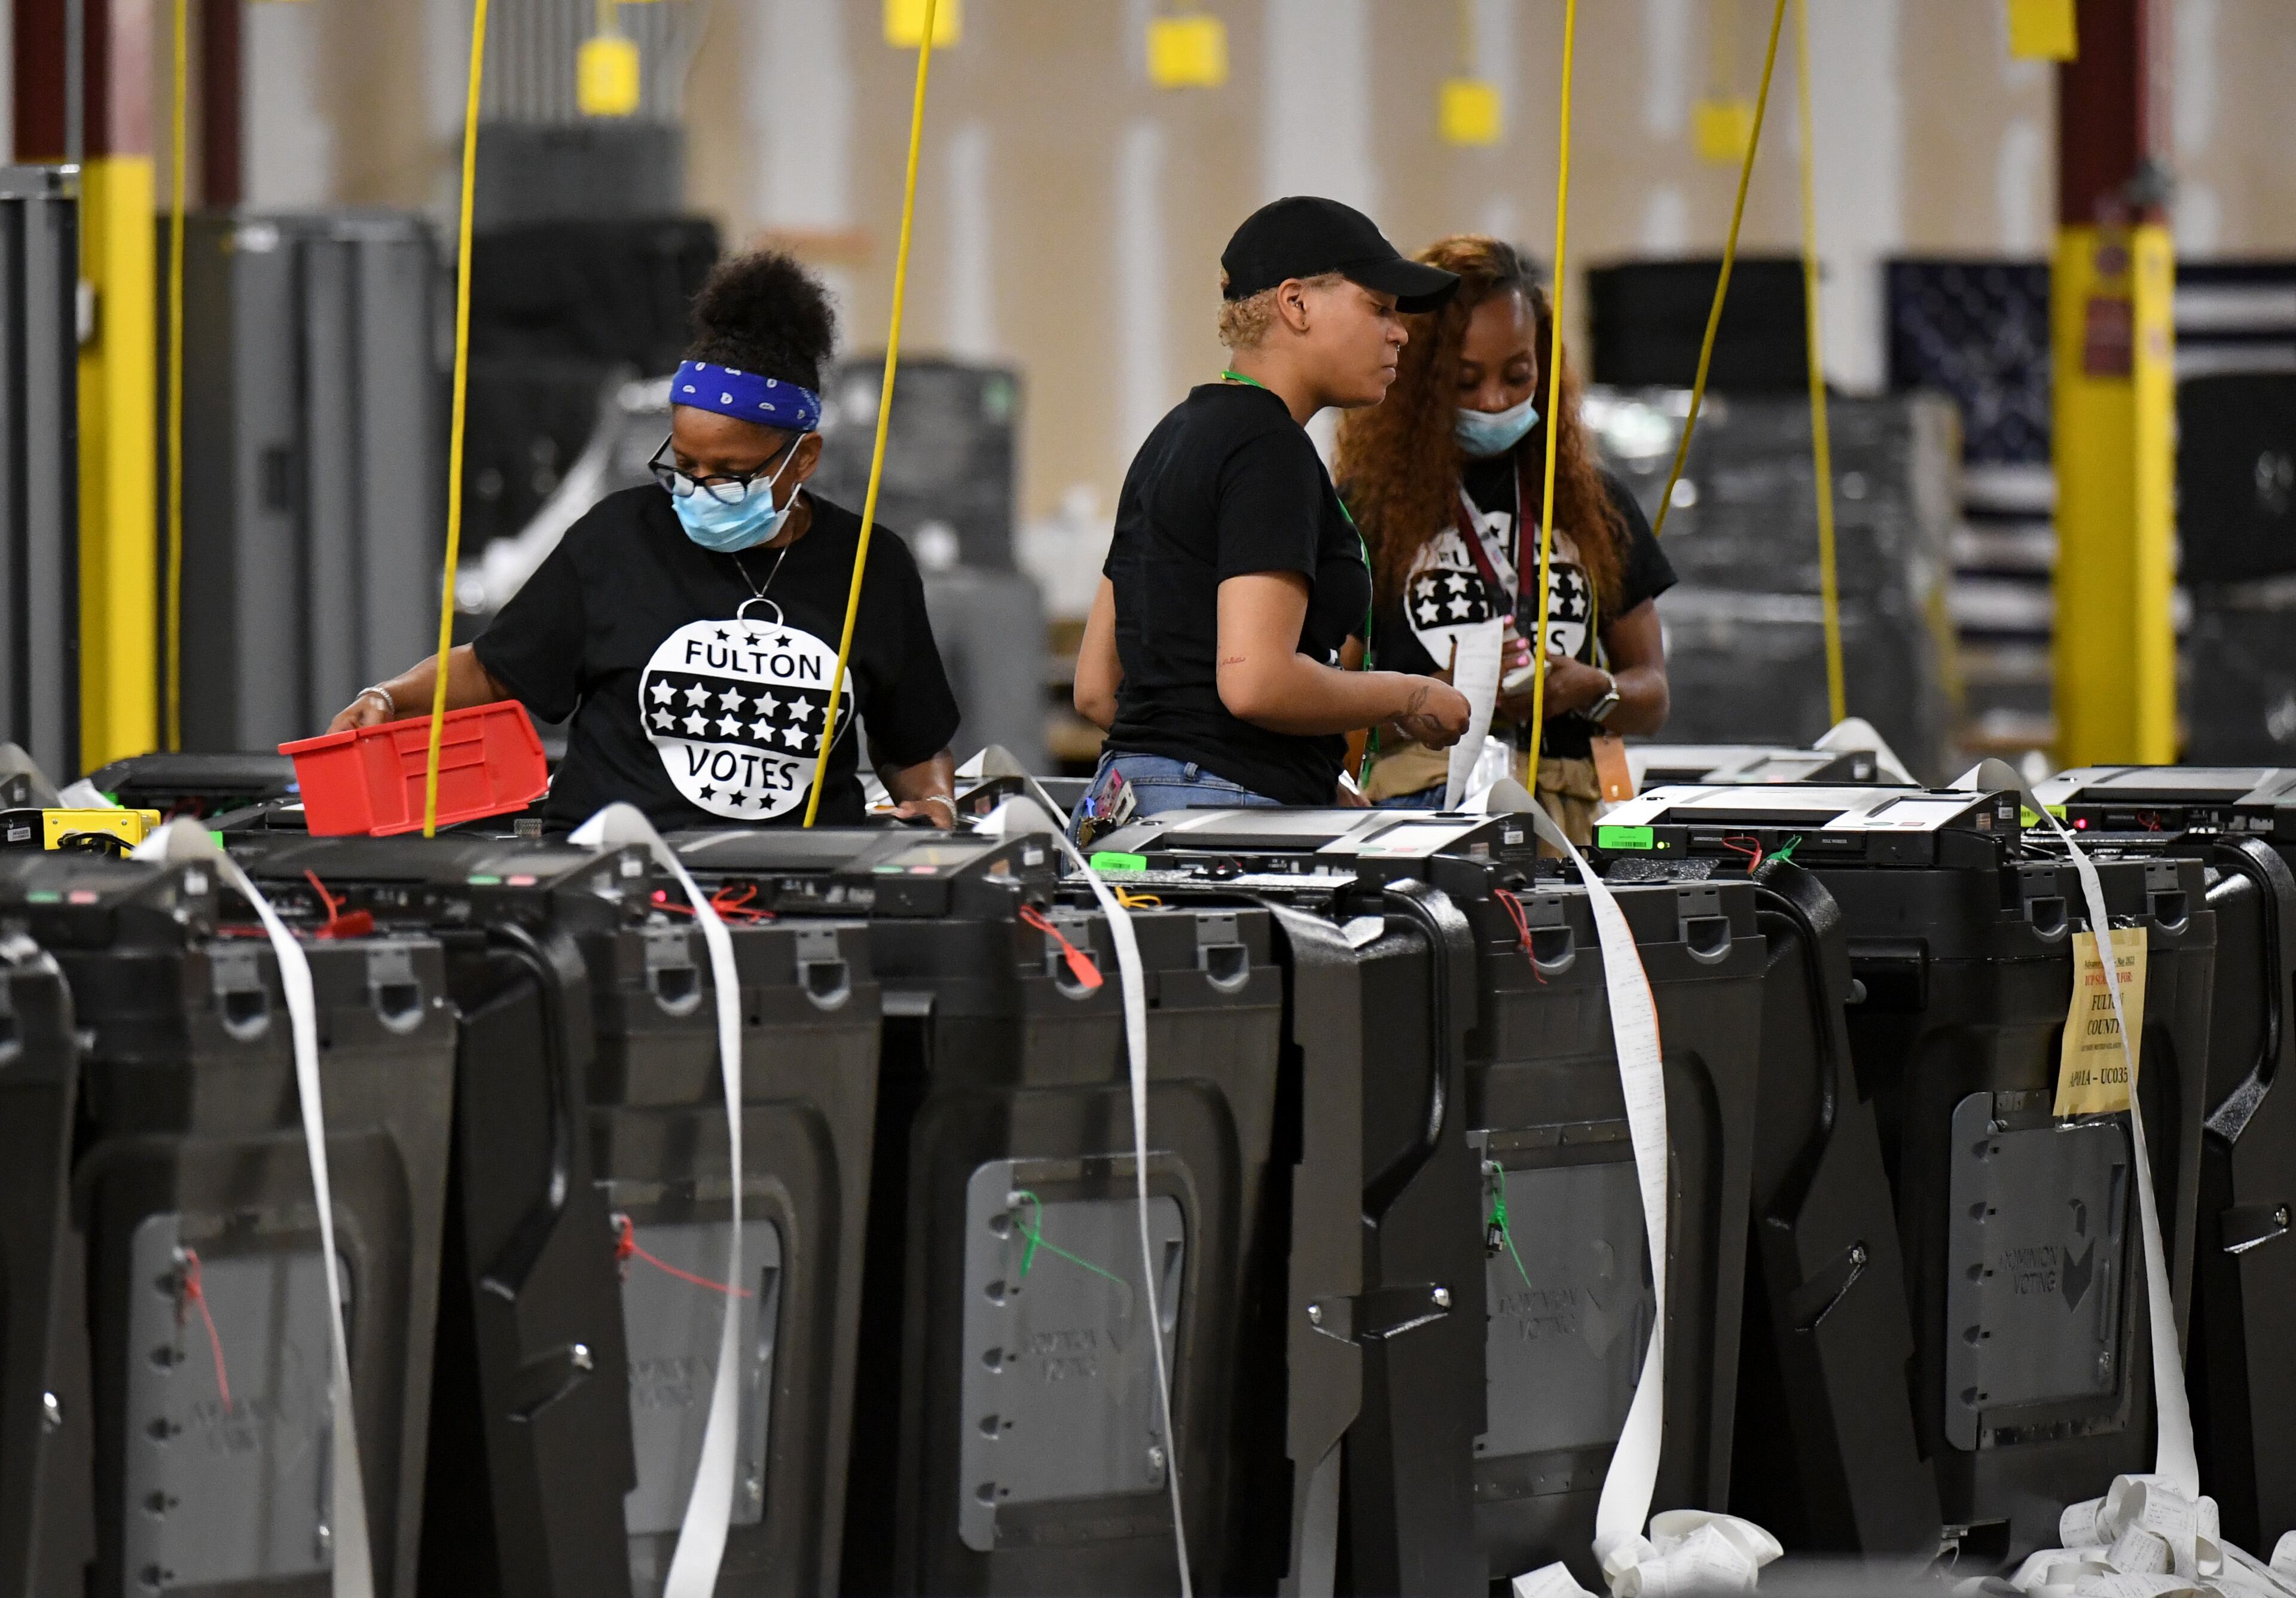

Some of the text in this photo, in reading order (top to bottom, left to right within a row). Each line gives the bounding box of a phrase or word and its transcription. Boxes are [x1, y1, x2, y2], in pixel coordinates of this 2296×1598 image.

[685, 639, 821, 681] FULTON
[685, 744, 799, 792] VOTES
[2100, 1067, 2129, 1084] UC035
